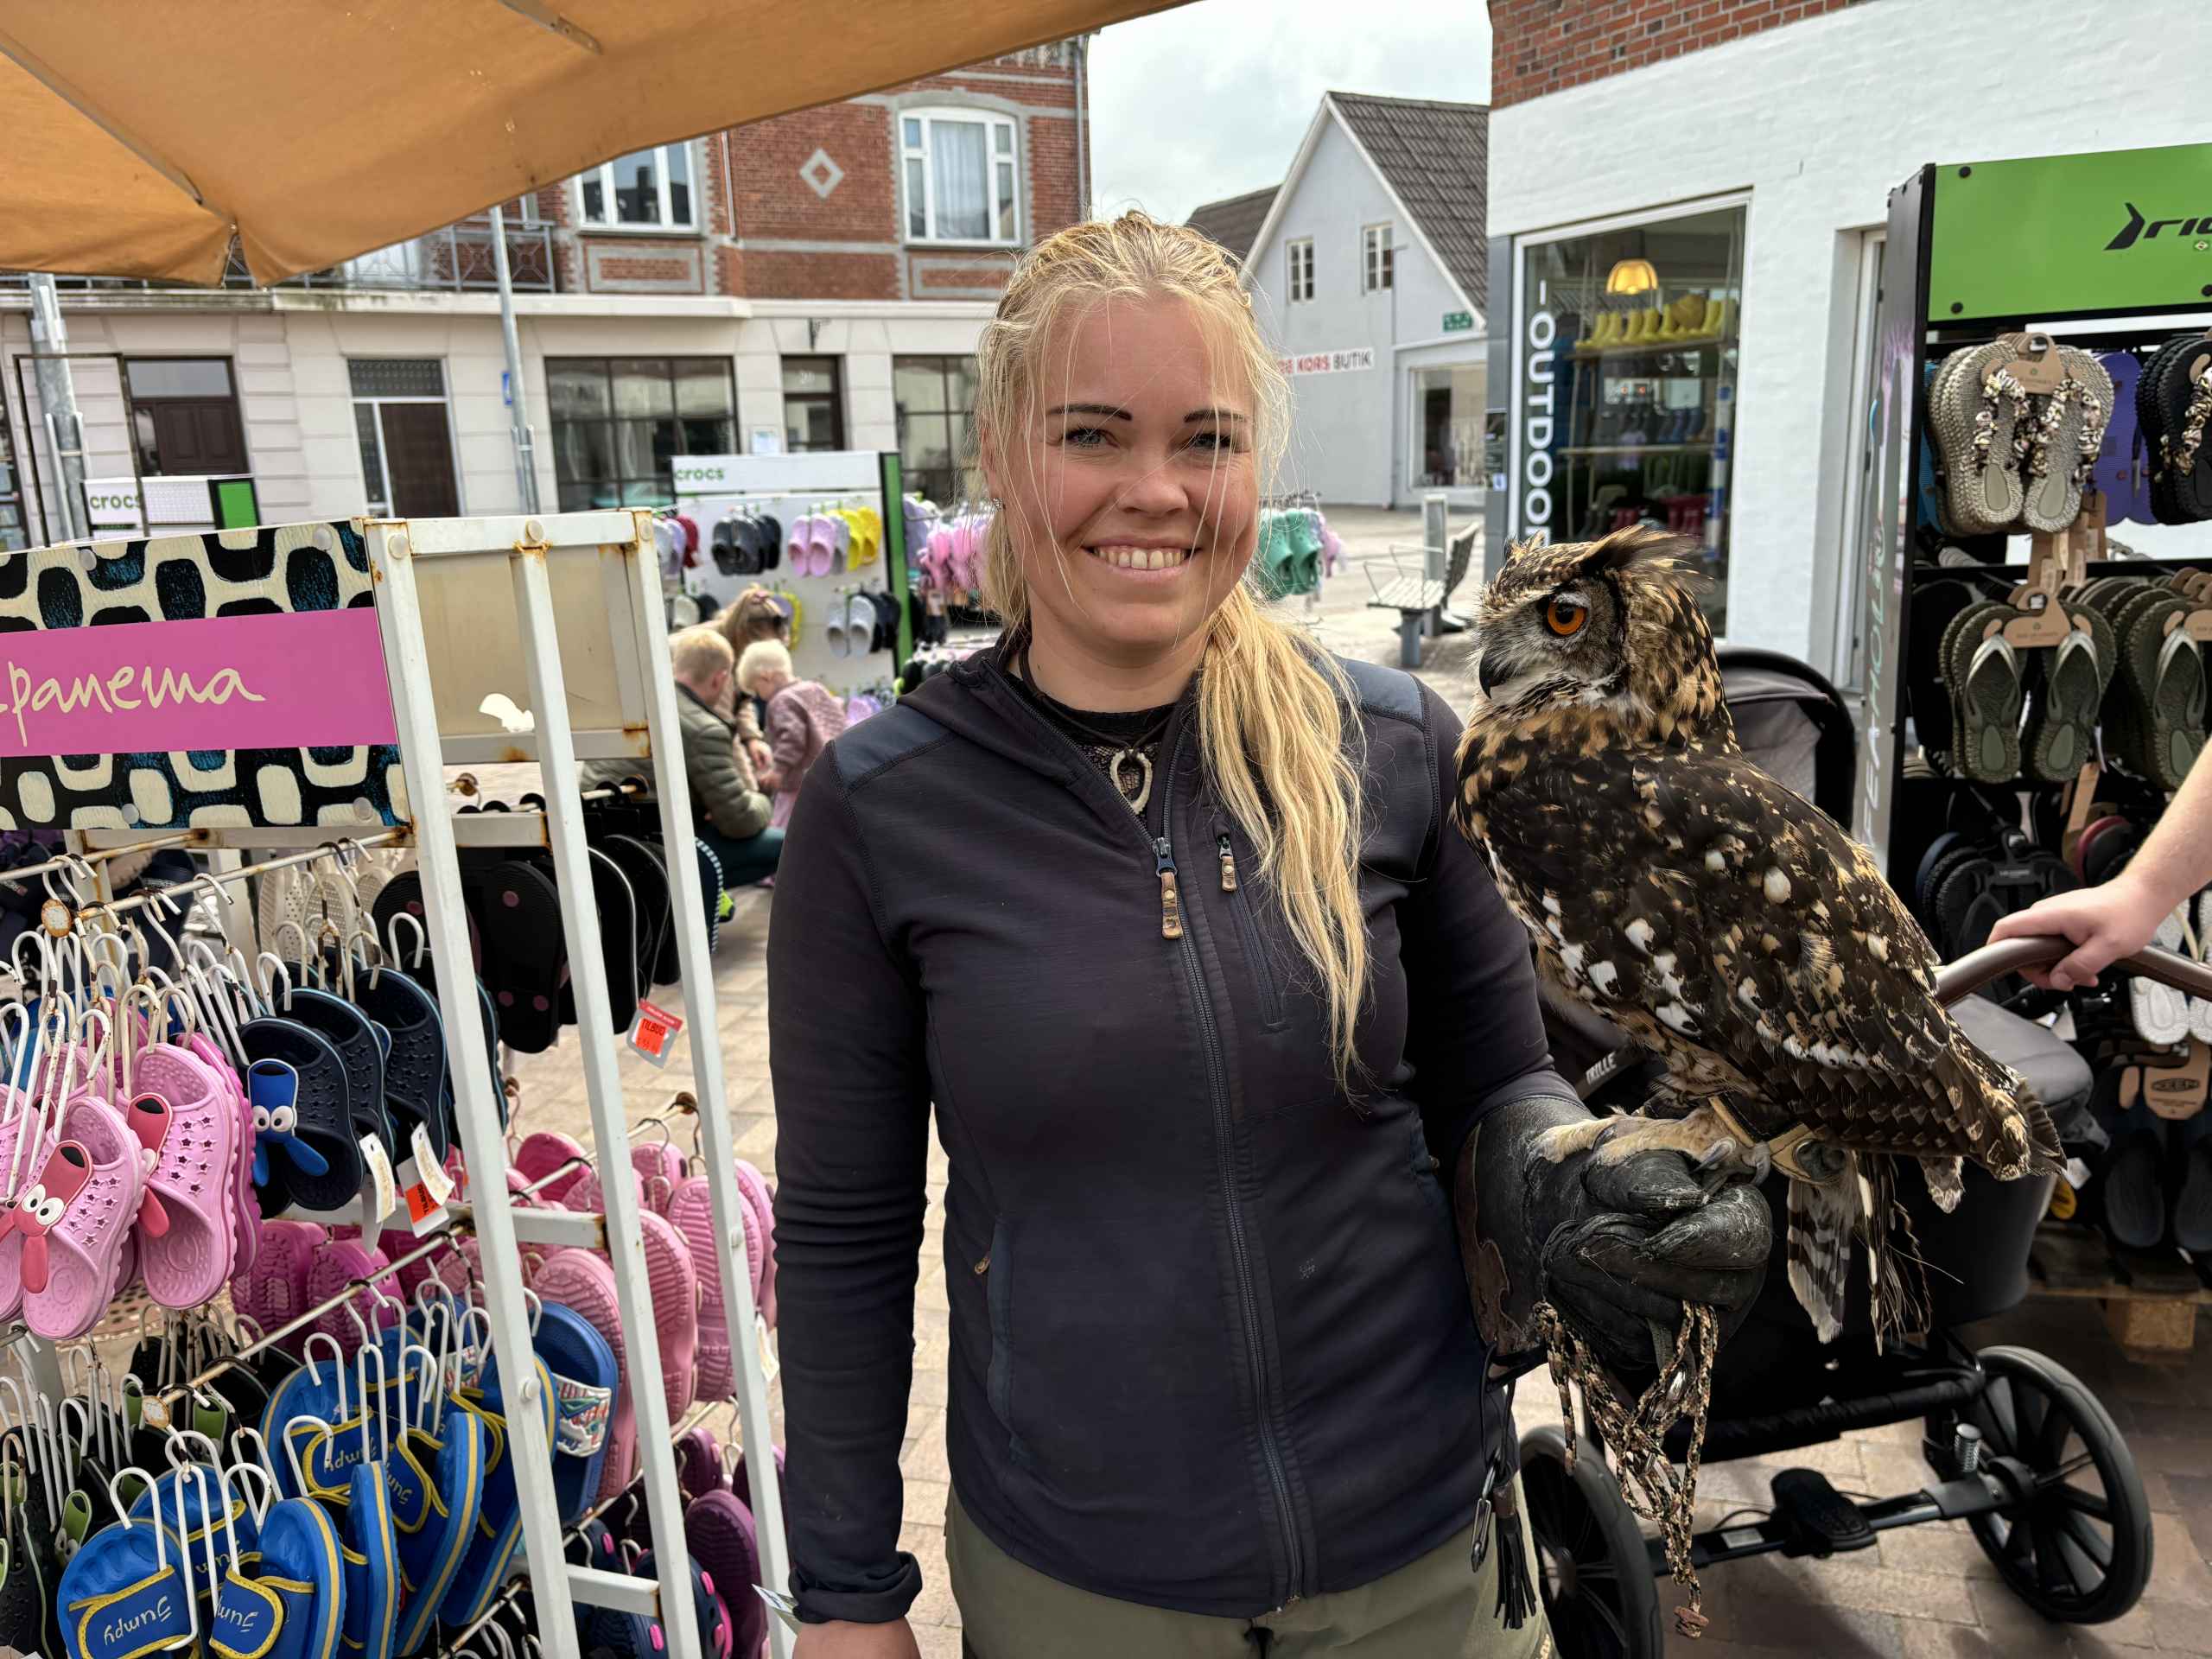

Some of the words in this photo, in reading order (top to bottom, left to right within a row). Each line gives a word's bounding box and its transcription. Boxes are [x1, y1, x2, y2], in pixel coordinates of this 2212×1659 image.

[1333, 351, 1371, 370] BUTIK
[675, 467, 724, 480] crocs
[0, 661, 266, 747] panema
[104, 1595, 175, 1646] Jumpy
